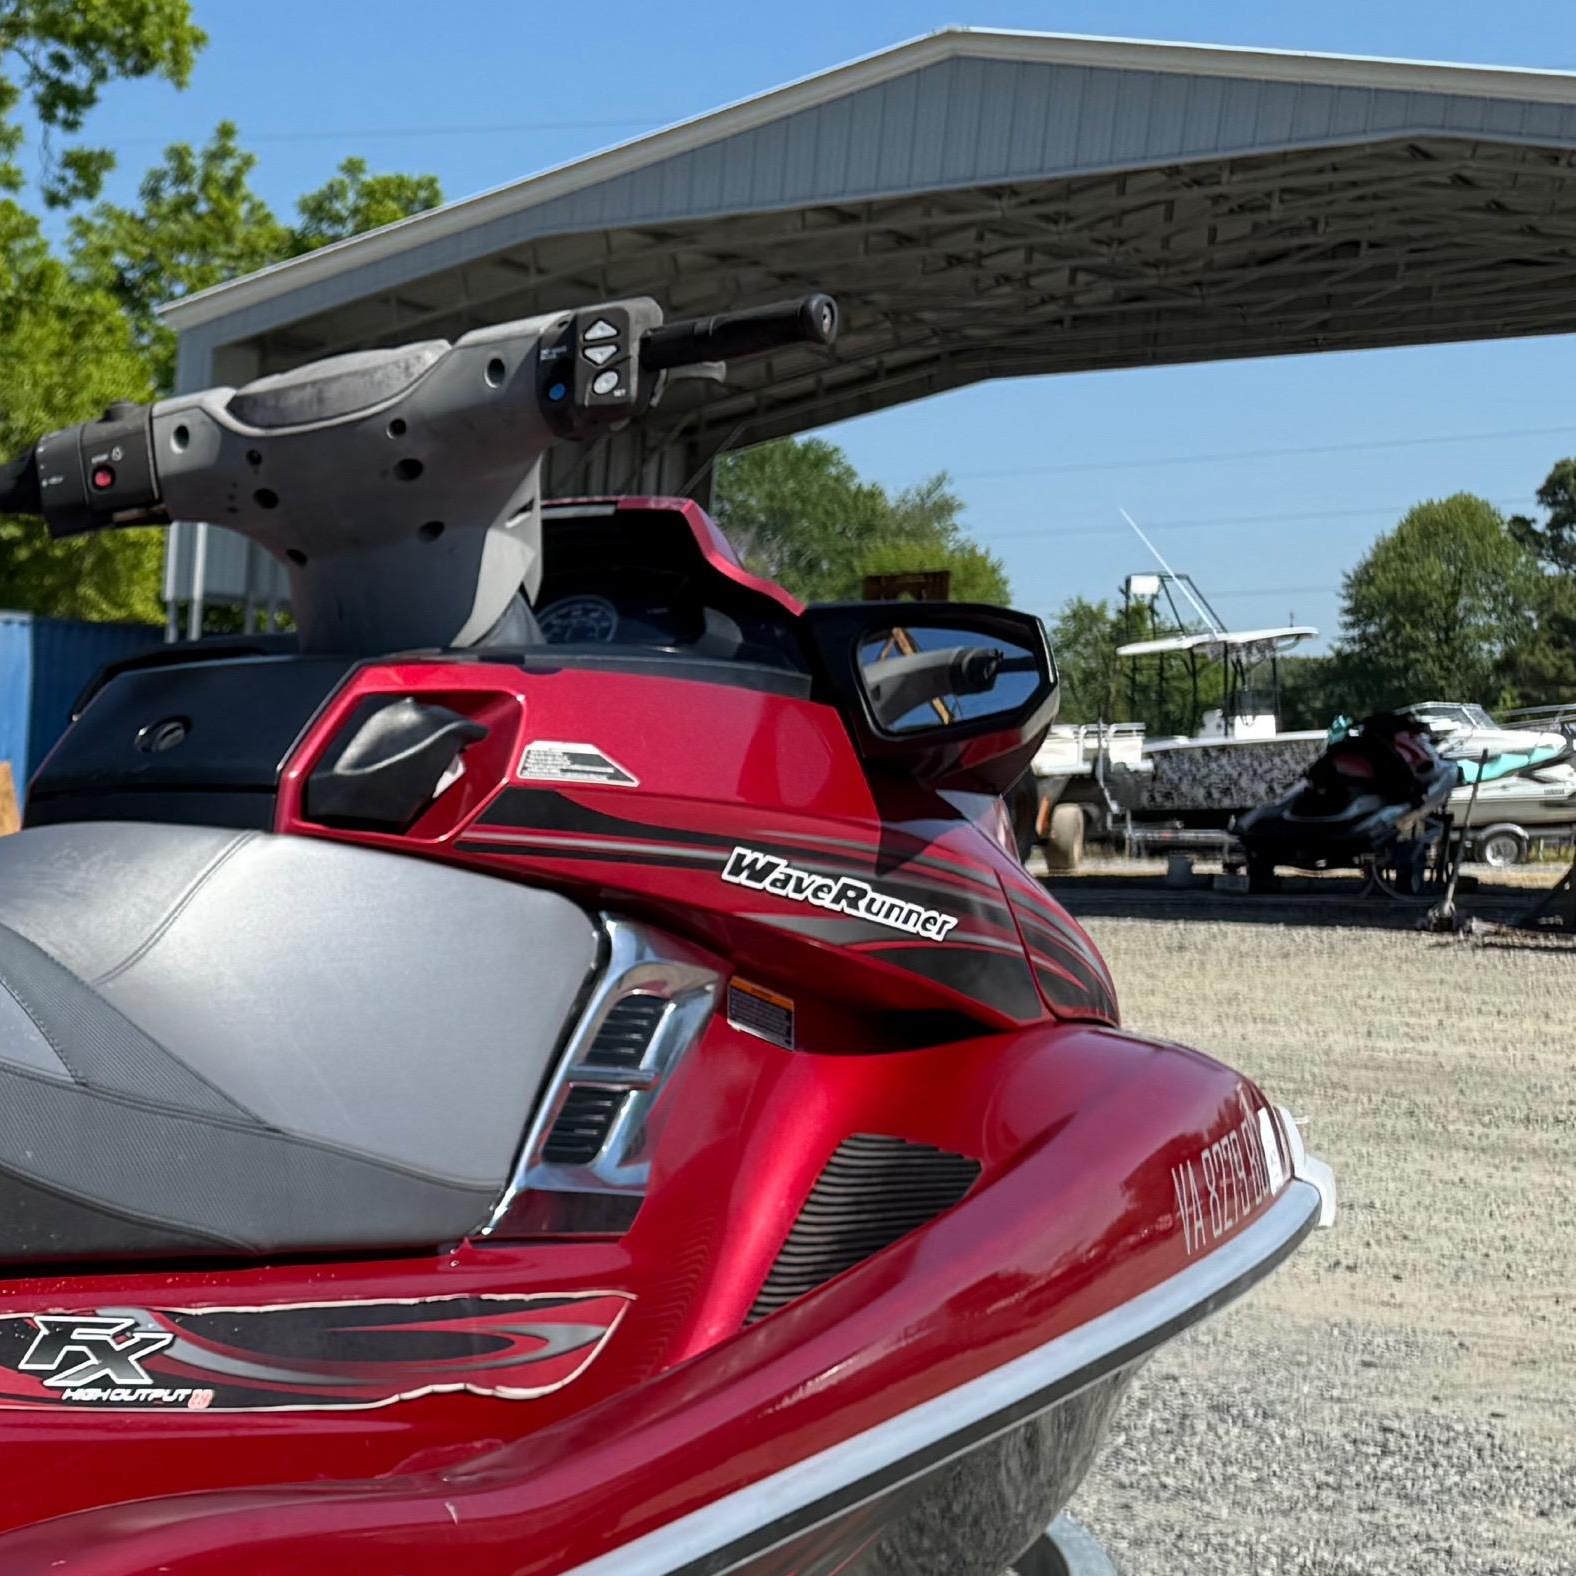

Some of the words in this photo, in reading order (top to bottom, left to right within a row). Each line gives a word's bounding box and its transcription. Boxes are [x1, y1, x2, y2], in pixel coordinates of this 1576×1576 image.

[722, 846, 958, 941] WaveRunner
[1171, 1159, 1206, 1255] VA
[17, 1315, 175, 1387] FX
[62, 1388, 110, 1401] HIGH
[110, 1388, 192, 1402] OUTPUT
